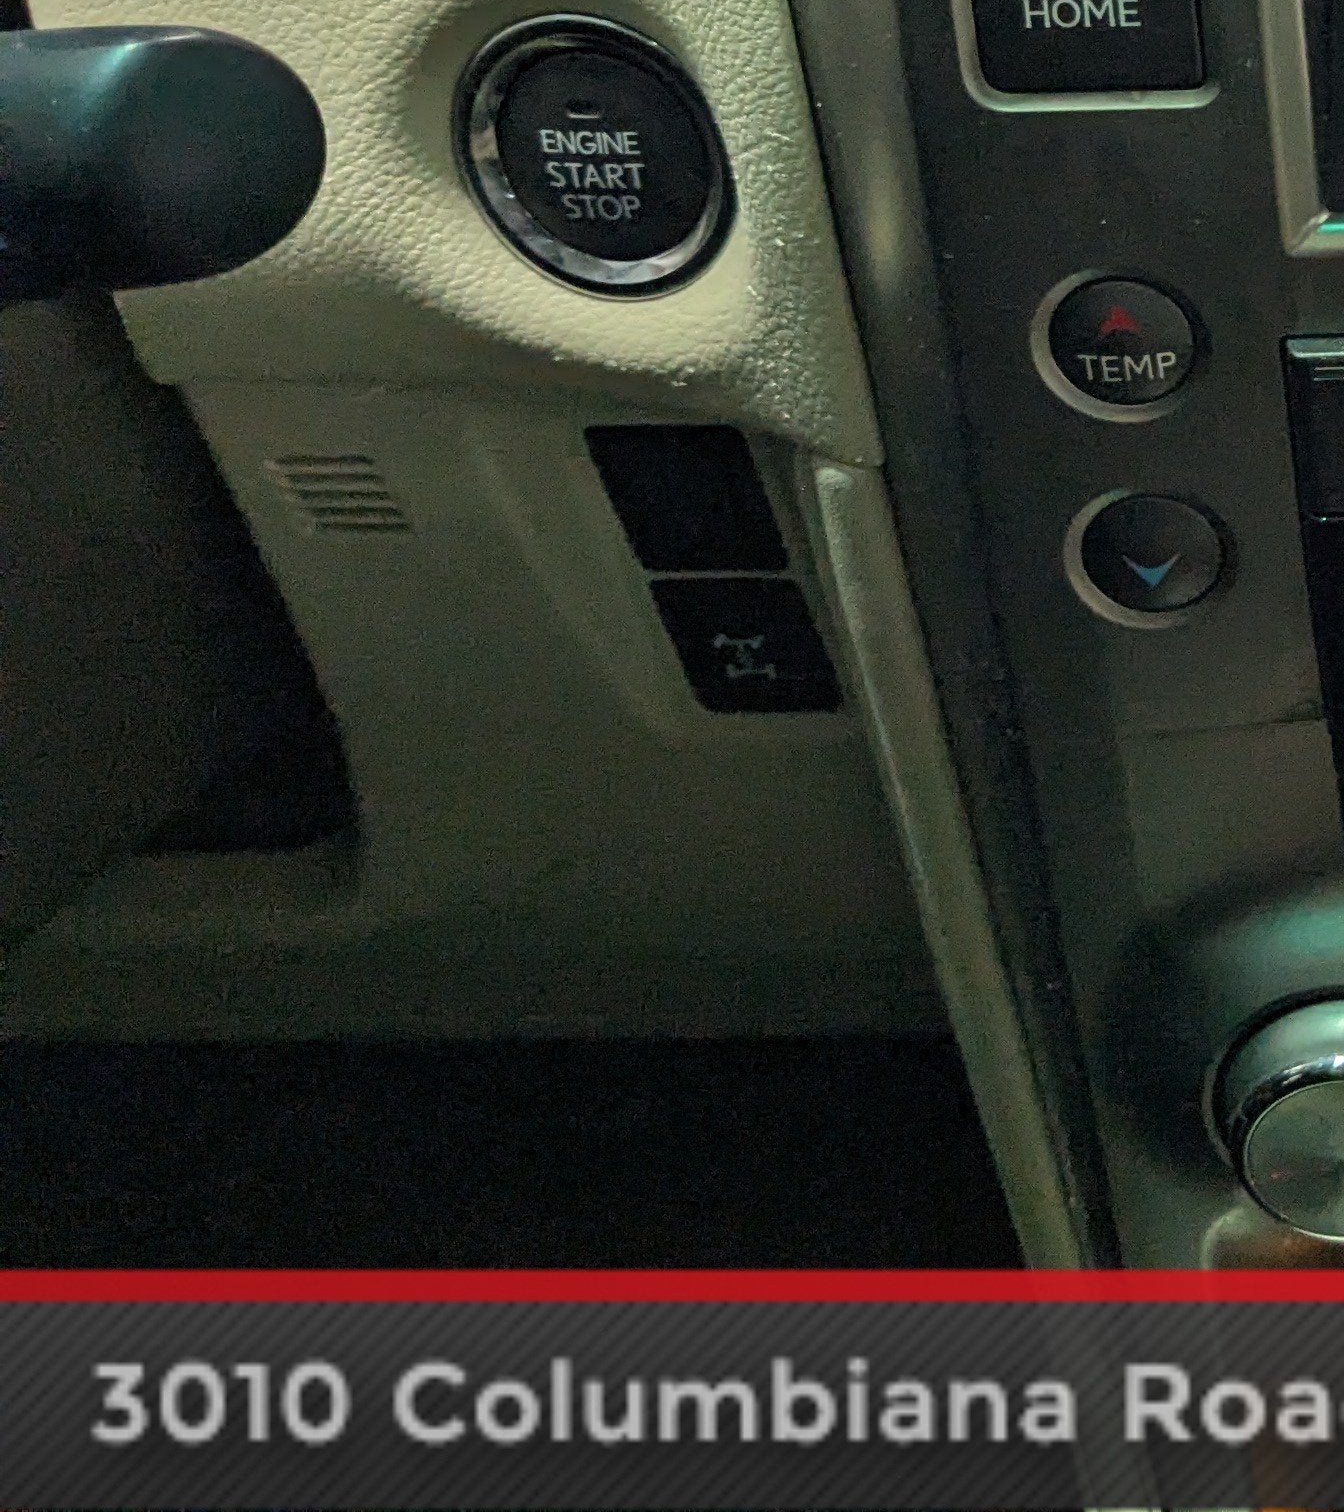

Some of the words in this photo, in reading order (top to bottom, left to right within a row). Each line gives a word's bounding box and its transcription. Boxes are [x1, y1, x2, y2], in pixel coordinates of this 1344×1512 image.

[539, 129, 642, 156] ENGINE
[545, 162, 645, 190] START
[562, 193, 642, 221] STOP
[1077, 351, 1177, 382] TEMP
